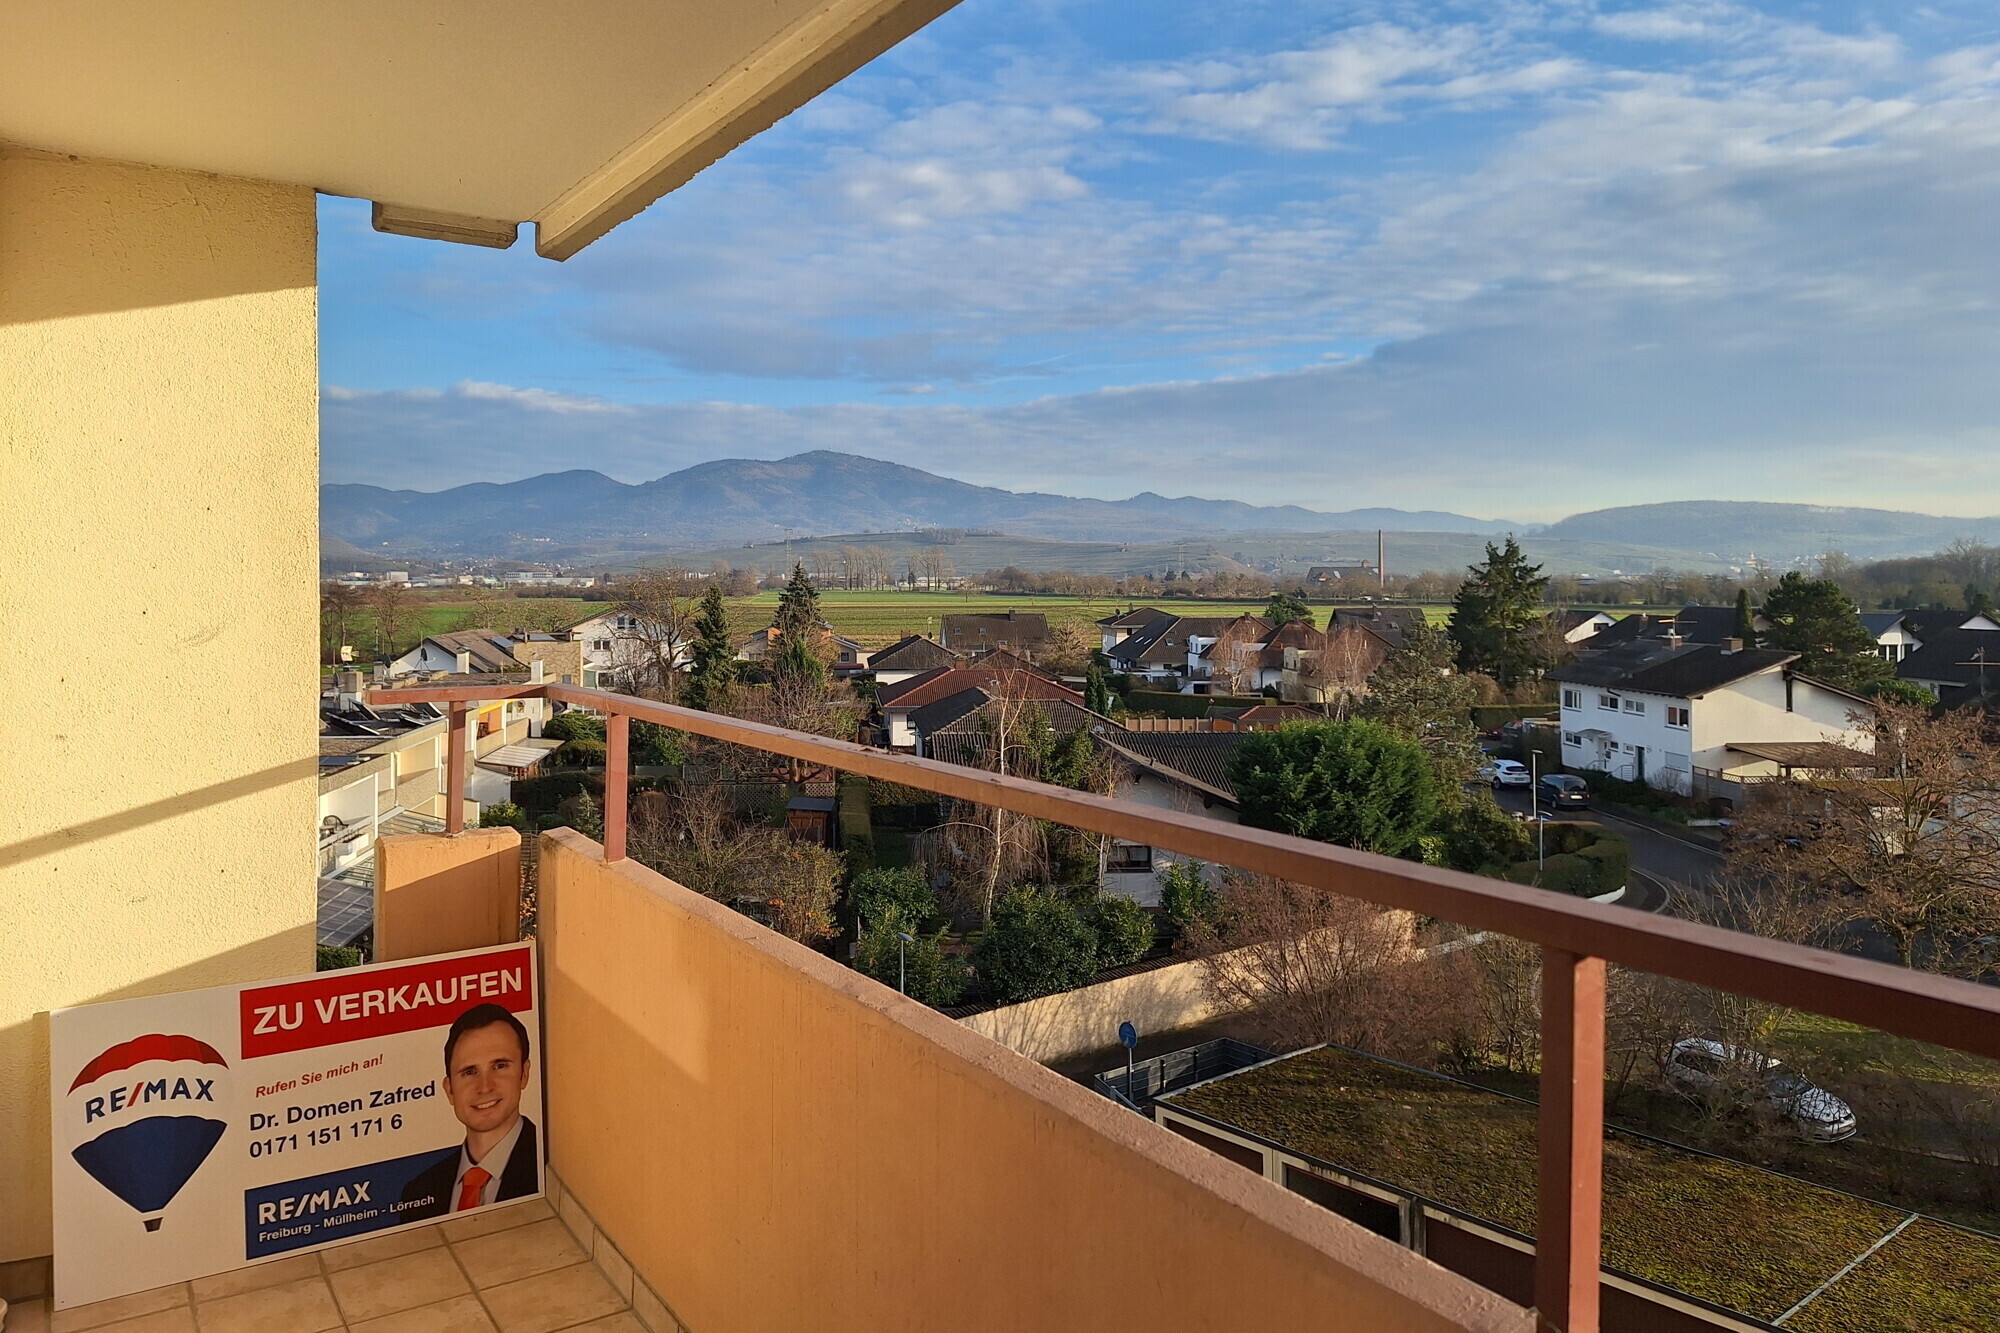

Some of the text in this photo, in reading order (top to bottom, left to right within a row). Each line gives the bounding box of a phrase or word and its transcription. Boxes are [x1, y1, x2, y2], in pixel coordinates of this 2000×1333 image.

[253, 966, 522, 1036] ZU VERKAUFEN
[255, 1054, 384, 1098] Rufen Sie mich an!
[85, 1077, 215, 1124] RE/MAX
[250, 1080, 436, 1132] Dr. Domen Zafred
[249, 1113, 403, 1159] 0171 151 171 6
[258, 1180, 372, 1226] RE/MAX
[258, 1223, 312, 1243] Freiburg
[323, 1208, 378, 1229] Müllheim
[389, 1195, 435, 1214] Lörrach
